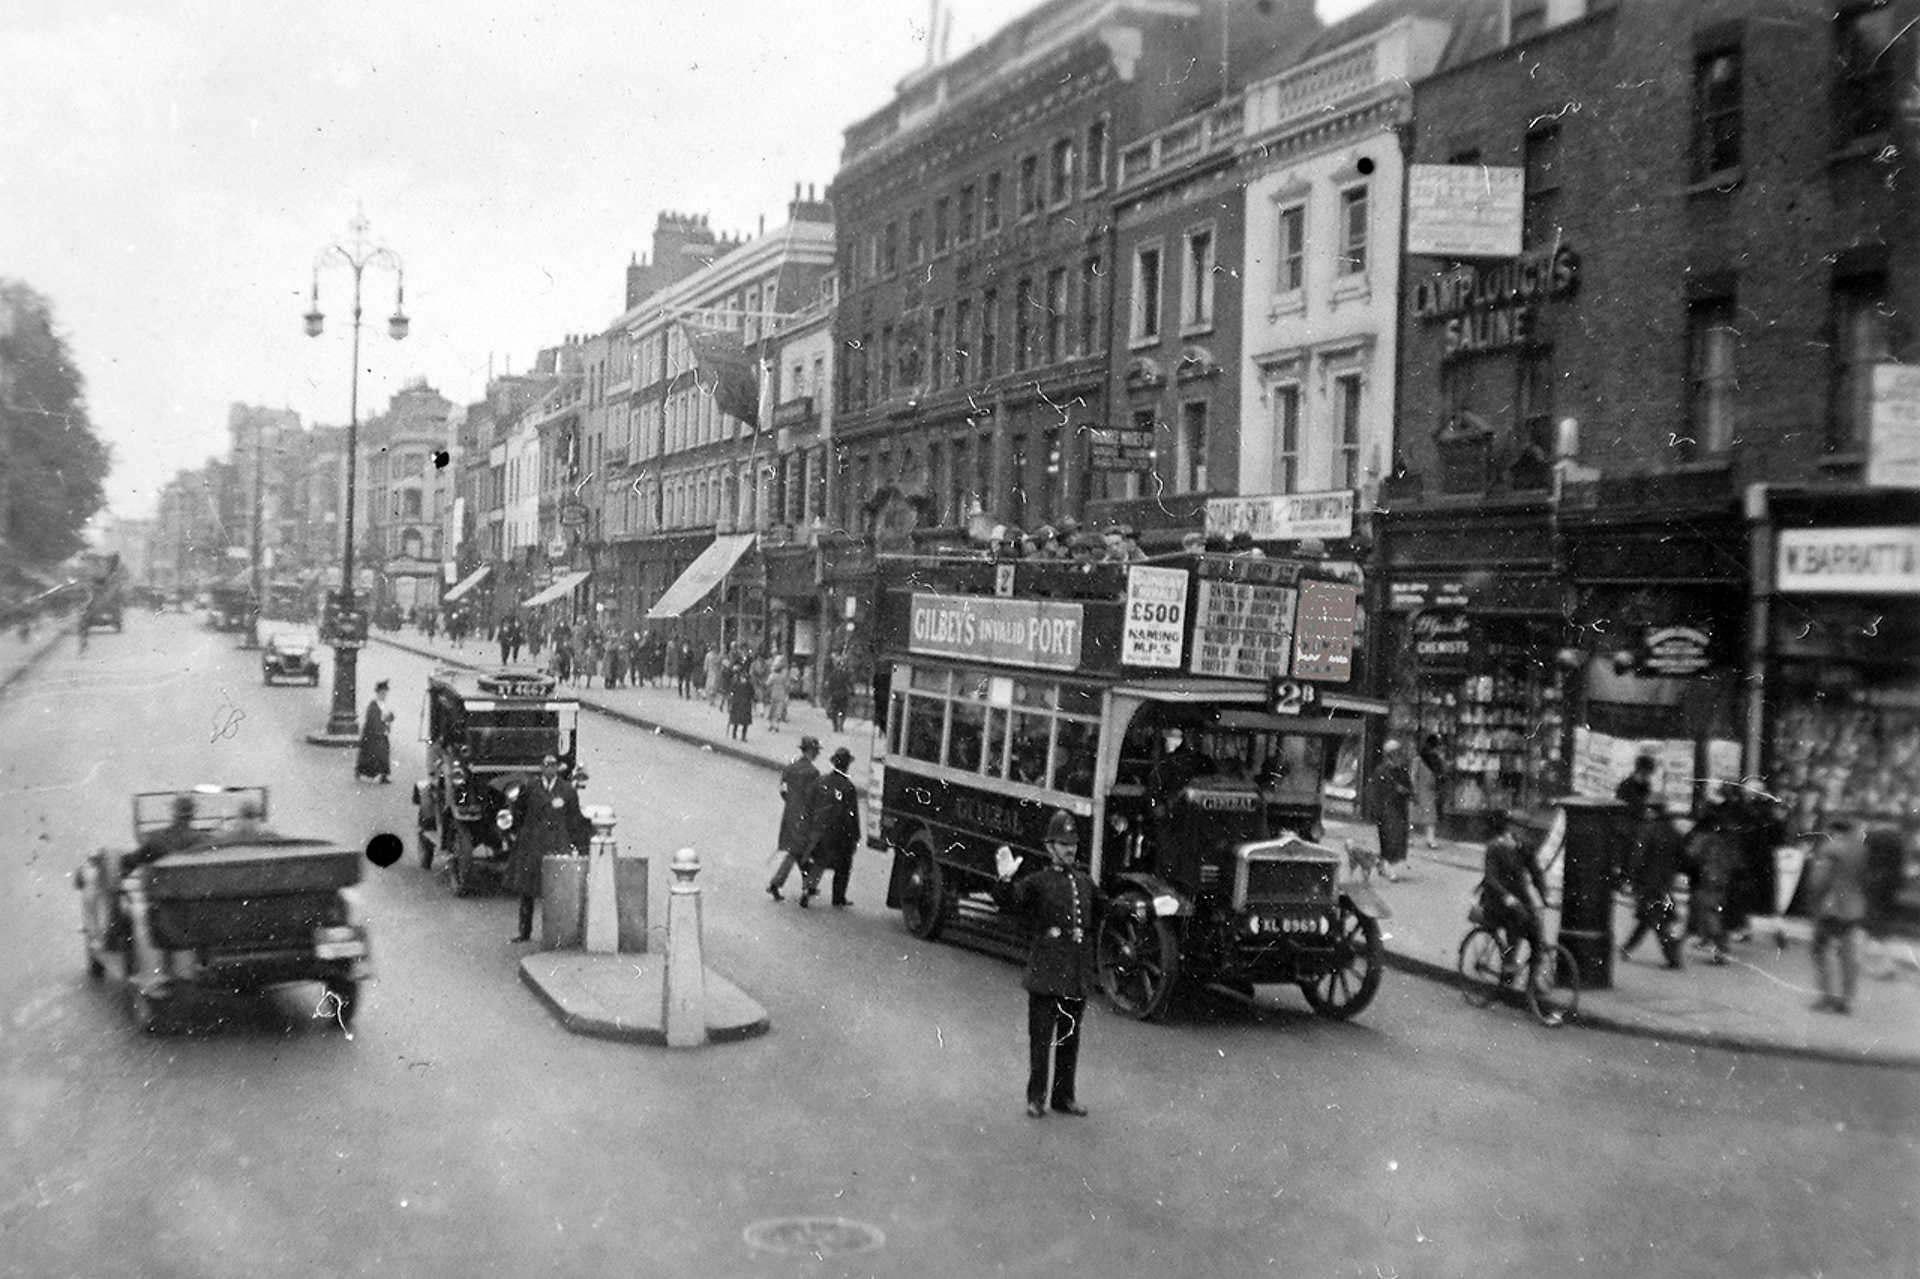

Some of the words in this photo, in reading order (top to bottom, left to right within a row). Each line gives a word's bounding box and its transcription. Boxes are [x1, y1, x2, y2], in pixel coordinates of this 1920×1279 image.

[1444, 307, 1528, 352] SALINE
[1001, 568, 1010, 592] 2
[1130, 602, 1180, 623] £500
[914, 607, 976, 646] GILBEY'S
[979, 617, 1025, 645] INVALID
[1028, 616, 1077, 656] PORT
[1128, 629, 1180, 642] NAMING
